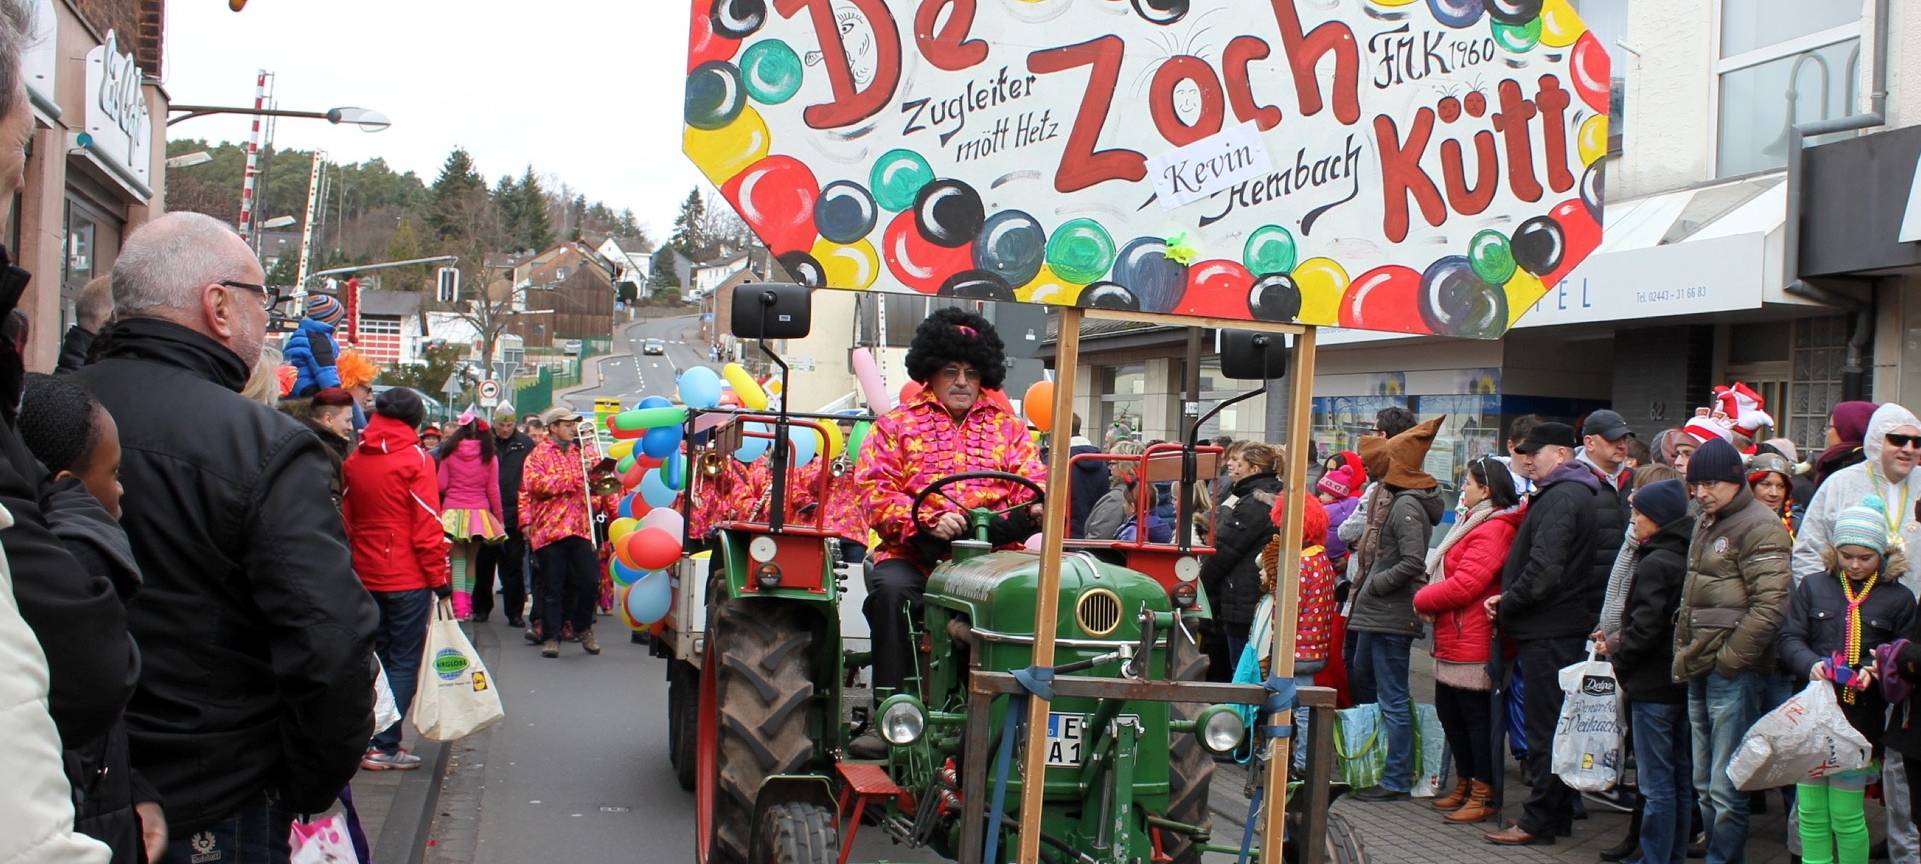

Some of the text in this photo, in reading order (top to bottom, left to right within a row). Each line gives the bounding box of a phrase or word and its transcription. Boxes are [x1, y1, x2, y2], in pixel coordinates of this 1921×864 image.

[773, 0, 989, 129] De
[1449, 37, 1495, 71] 1960
[901, 65, 1036, 148] Zugleiter
[956, 109, 1059, 162] mött Hetz
[1026, 0, 1361, 193] Zoch
[1164, 142, 1255, 195] Kevin
[1199, 133, 1362, 236] Hembach
[1373, 74, 1575, 243] Kütt
[1535, 278, 1592, 313] EL
